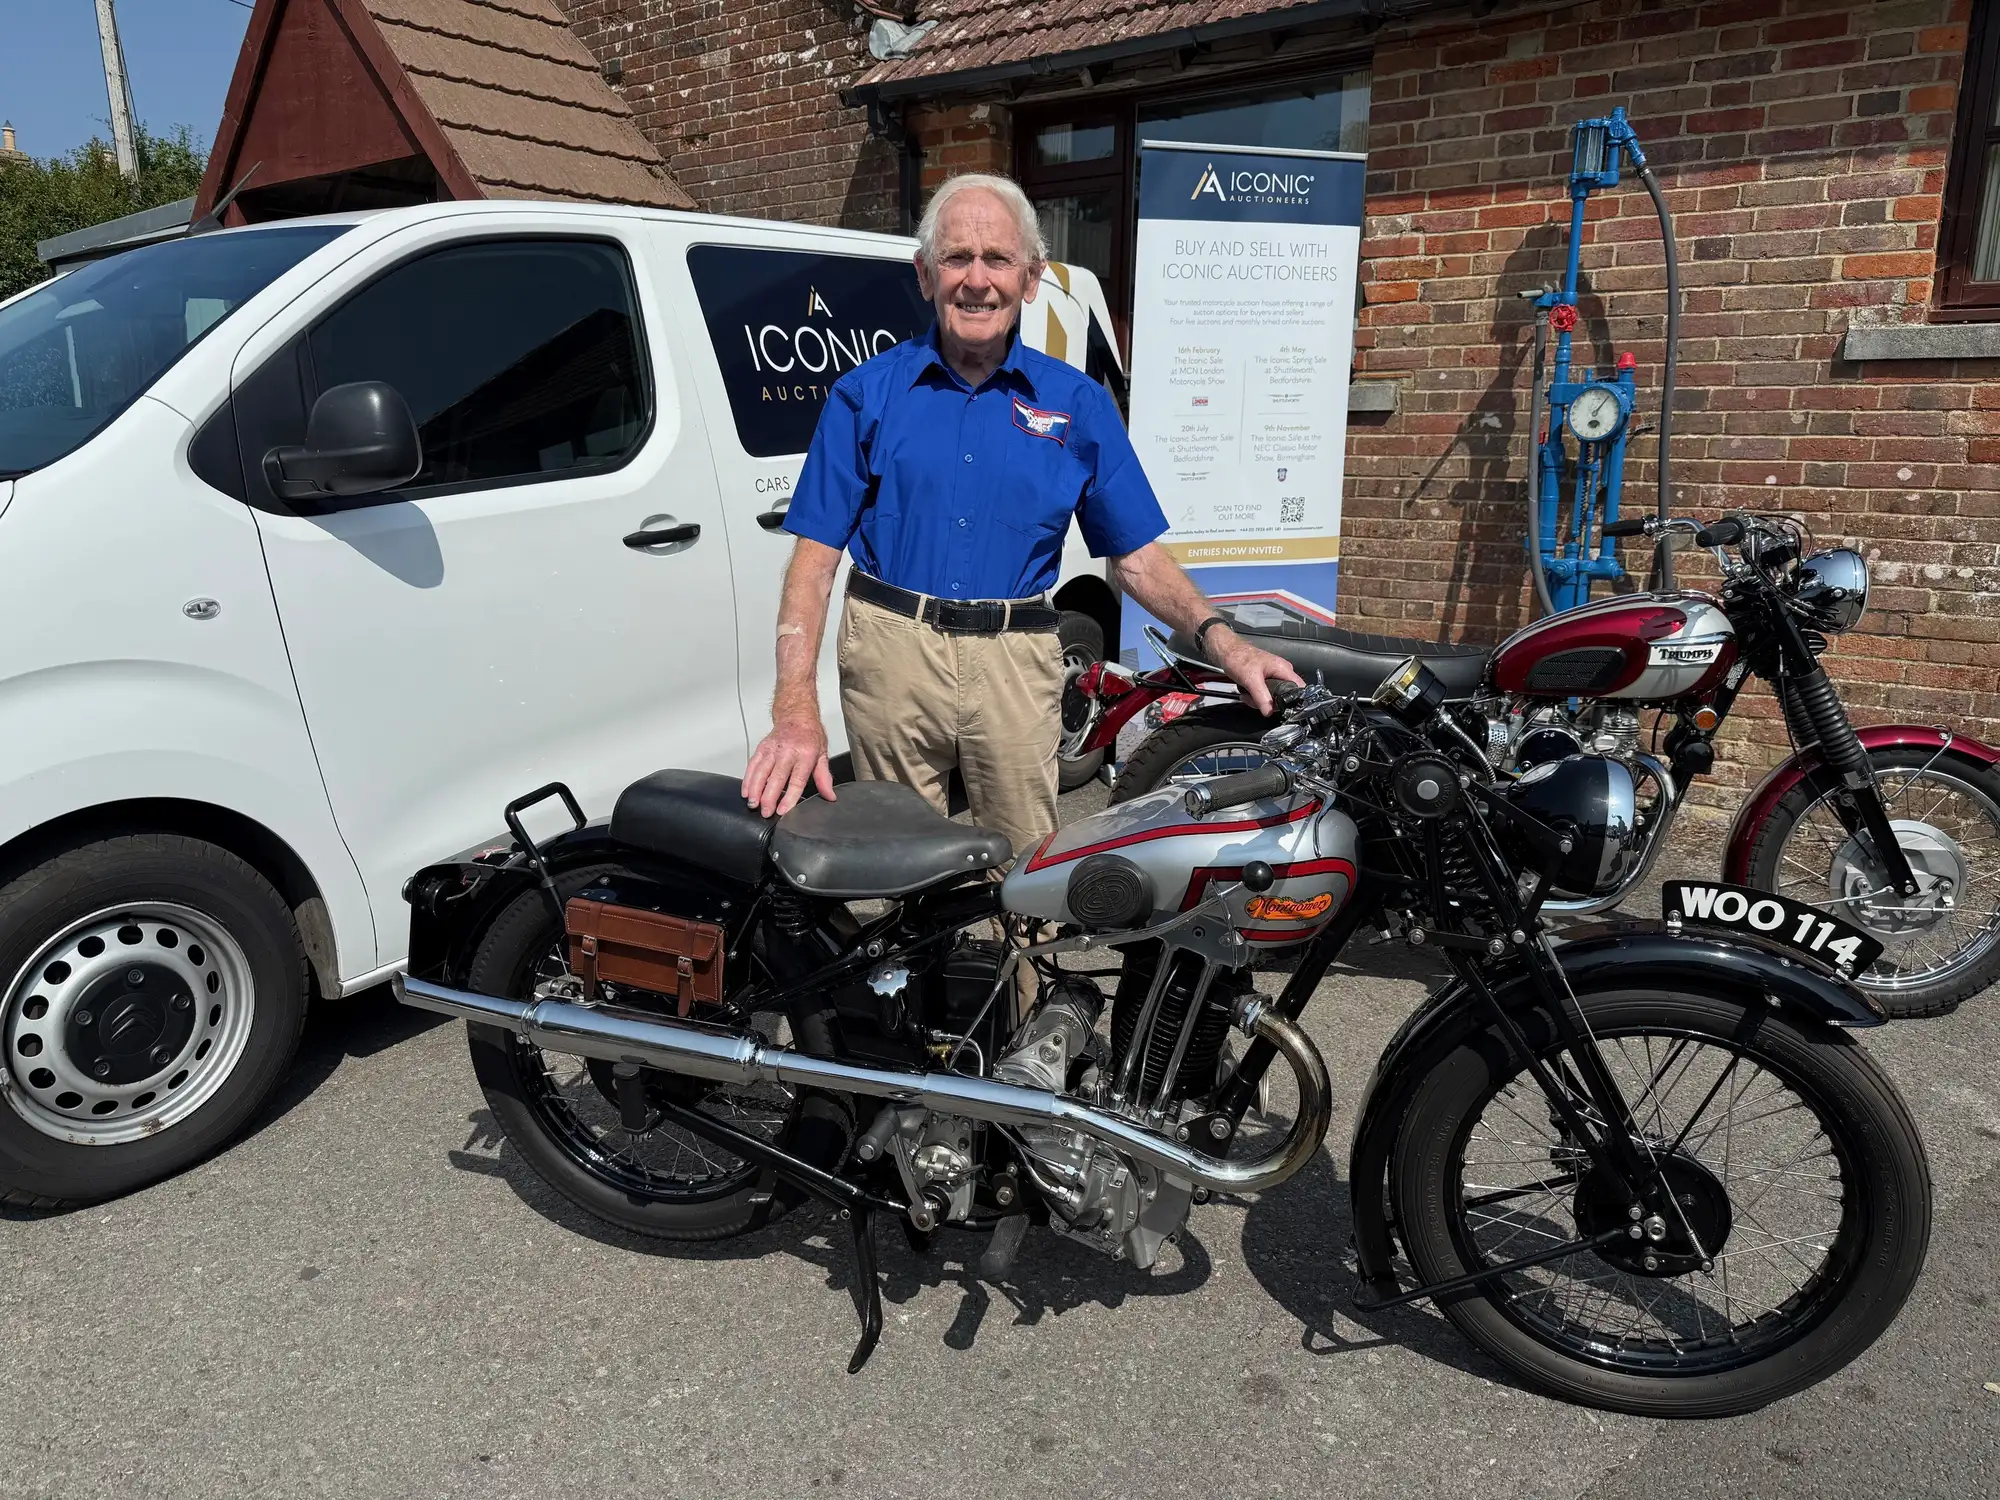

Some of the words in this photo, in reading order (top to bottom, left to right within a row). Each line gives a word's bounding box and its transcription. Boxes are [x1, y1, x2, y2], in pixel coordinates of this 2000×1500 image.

[1230, 171, 1310, 195] ICONIC
[1229, 195, 1310, 205] AUCTIONEERS
[1175, 239, 1205, 255] BUY
[1209, 241, 1244, 256] AND
[1249, 242, 1285, 258] SELL
[1289, 242, 1328, 258] WITH
[1162, 263, 1222, 280] ICONIC
[1227, 265, 1337, 282] AUCTIONEERS
[1164, 298, 1178, 306] Your
[1203, 299, 1236, 308] motorcycle
[1282, 299, 1304, 308] offering
[1250, 309, 1271, 317] buyers
[1235, 318, 1260, 326] monthly
[1178, 346, 1191, 354] 16th
[1193, 346, 1220, 355] February
[1292, 346, 1306, 355] May
[1210, 356, 1223, 364] Sale
[1292, 356, 1313, 365] Spring
[1170, 378, 1206, 386] Motorcycle
[1208, 377, 1225, 385] Show
[1197, 425, 1209, 433] July
[1277, 424, 1311, 432] November
[1155, 435, 1167, 443] The
[1191, 434, 1218, 442] Summer
[1220, 433, 1234, 441] Sale
[1298, 443, 1317, 451] Motor
[1277, 454, 1316, 462] Birmingham
[755, 476, 790, 493] CARS
[1234, 504, 1244, 512] TO
[1188, 548, 1220, 558] ENTRIES
[1222, 546, 1247, 556] NOW
[1248, 545, 1283, 555] INVITED
[1247, 897, 1330, 915] Montgomery
[1681, 887, 1785, 931] WOO
[1793, 913, 1862, 965] 114
